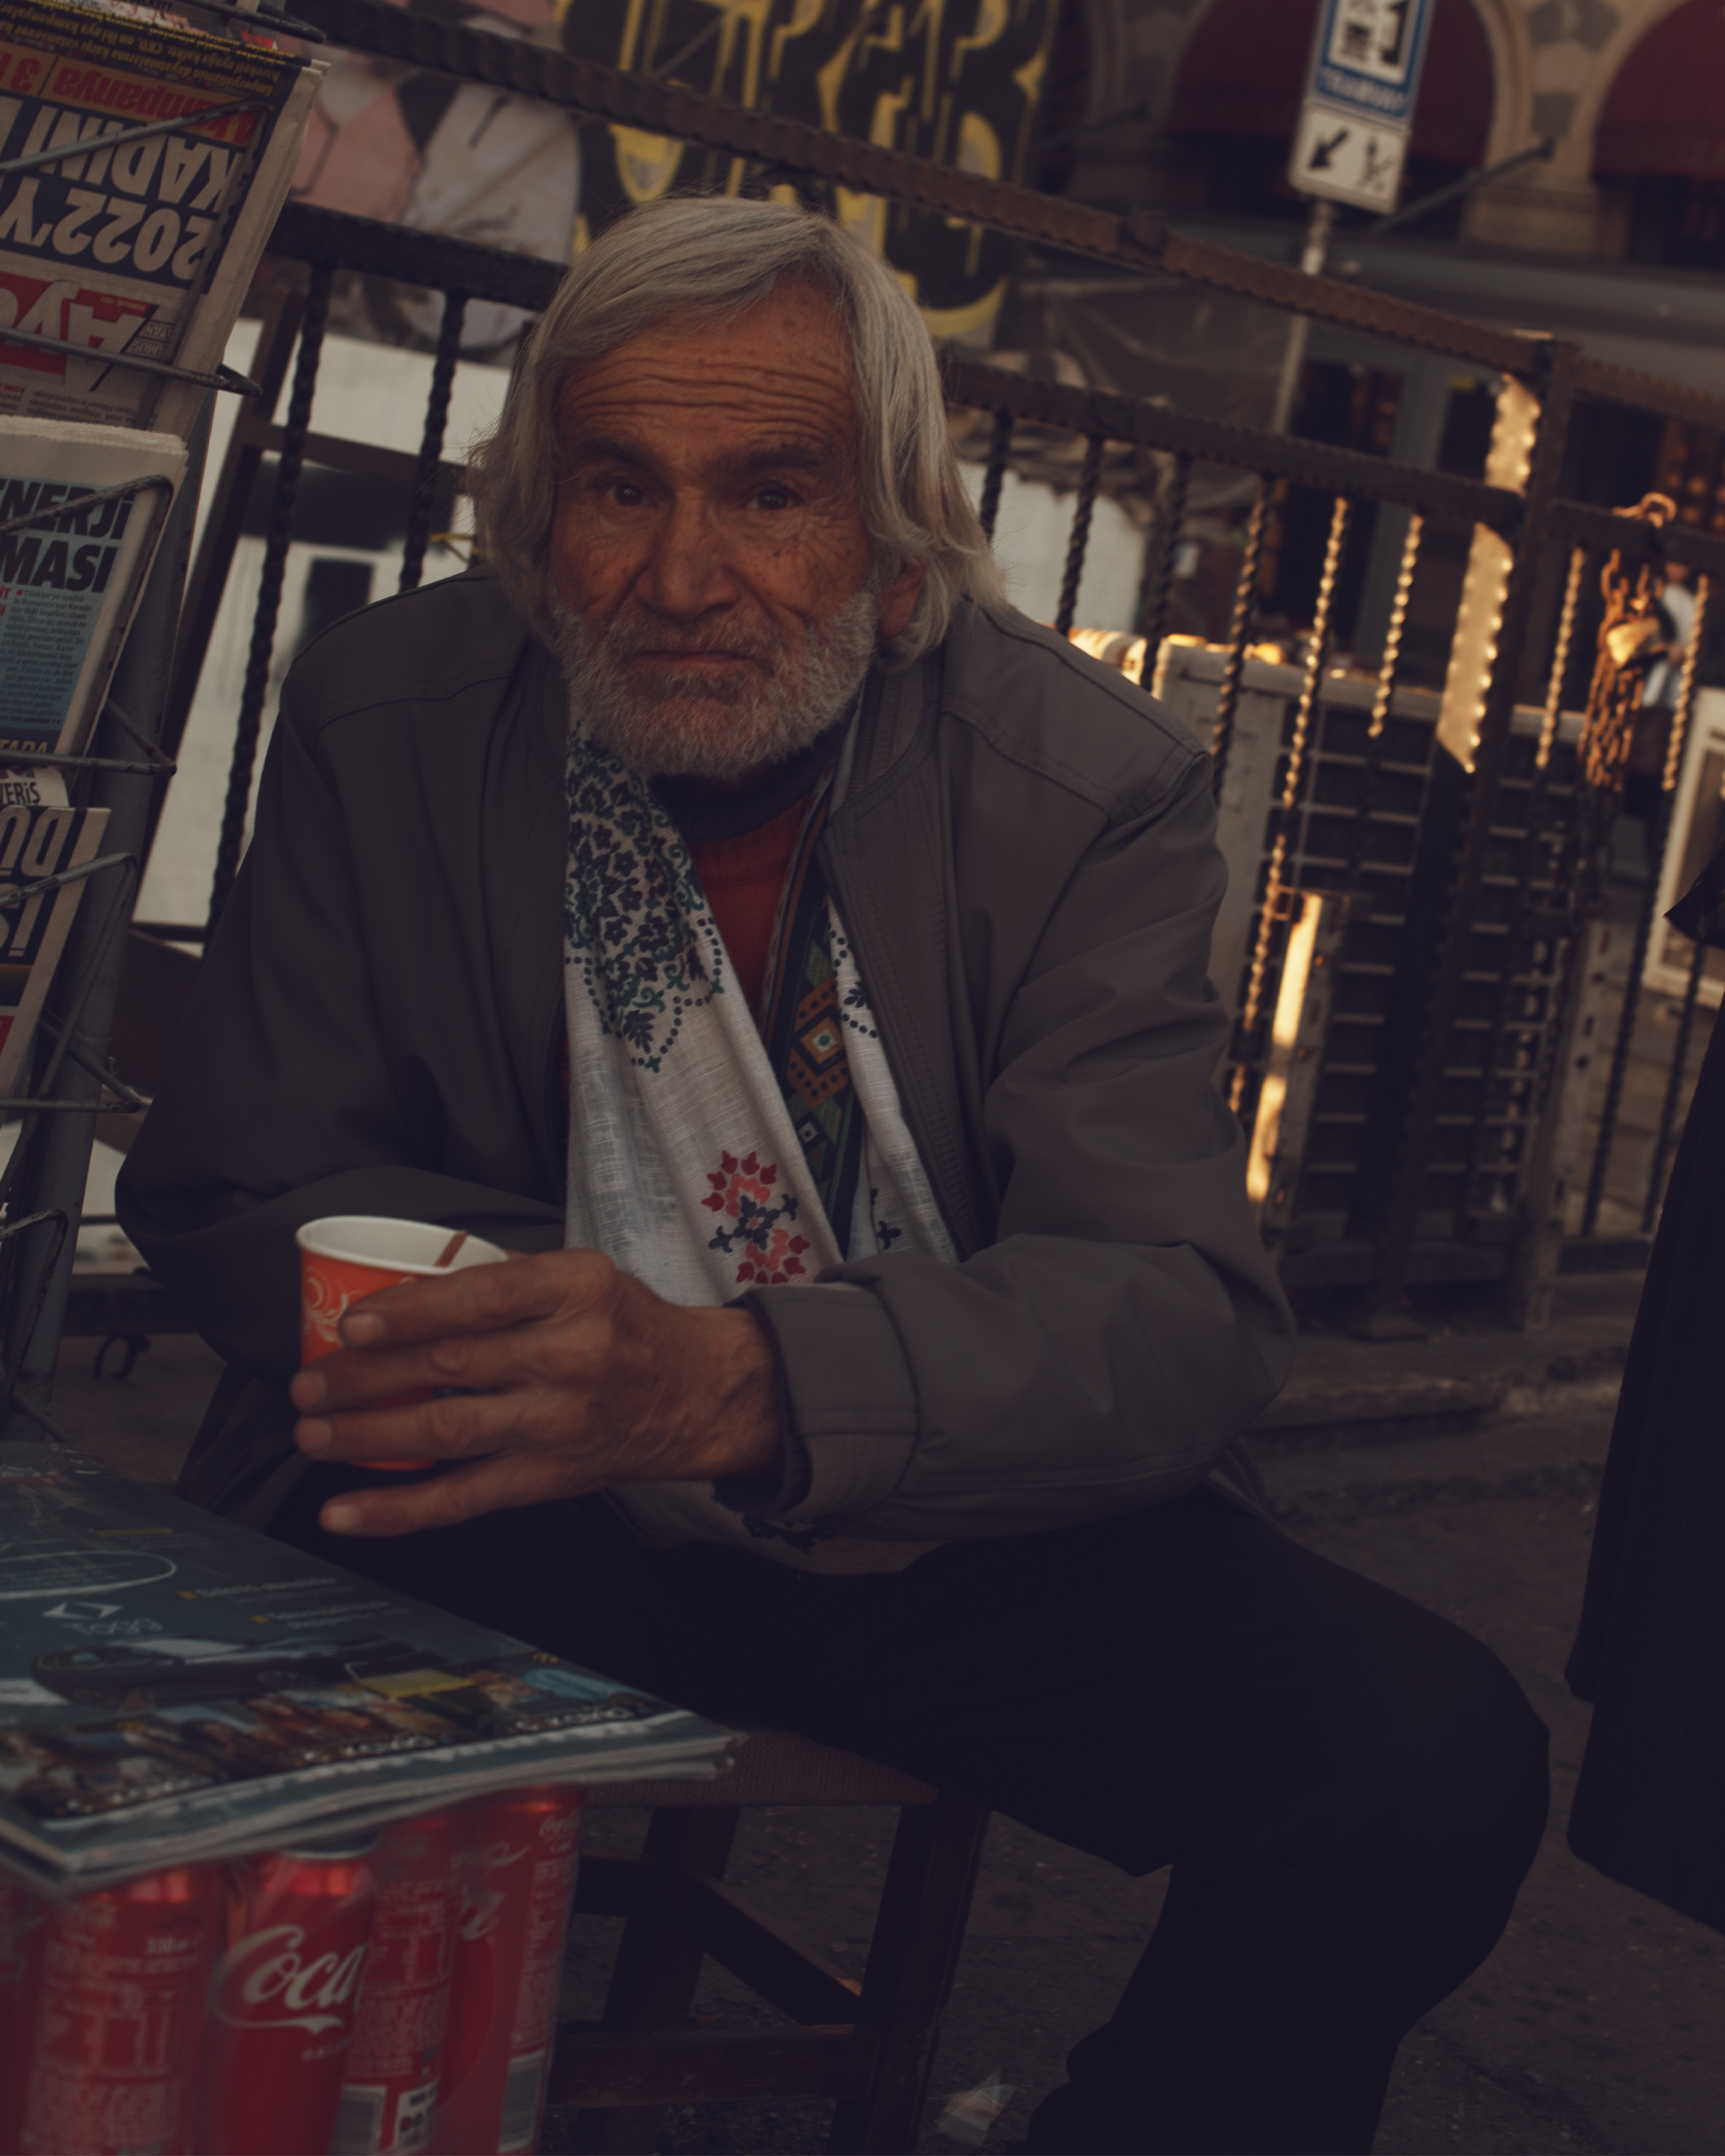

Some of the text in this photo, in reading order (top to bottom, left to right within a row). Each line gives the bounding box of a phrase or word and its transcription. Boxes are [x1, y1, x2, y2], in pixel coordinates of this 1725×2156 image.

[14, 25, 80, 50] vatansever
[81, 39, 110, 60] karşı
[118, 33, 135, 46] on
[9, 57, 42, 93] 3
[192, 69, 273, 97] Emperyalizmin
[0, 176, 219, 280] 2022'Y
[0, 479, 135, 540] NERJİ
